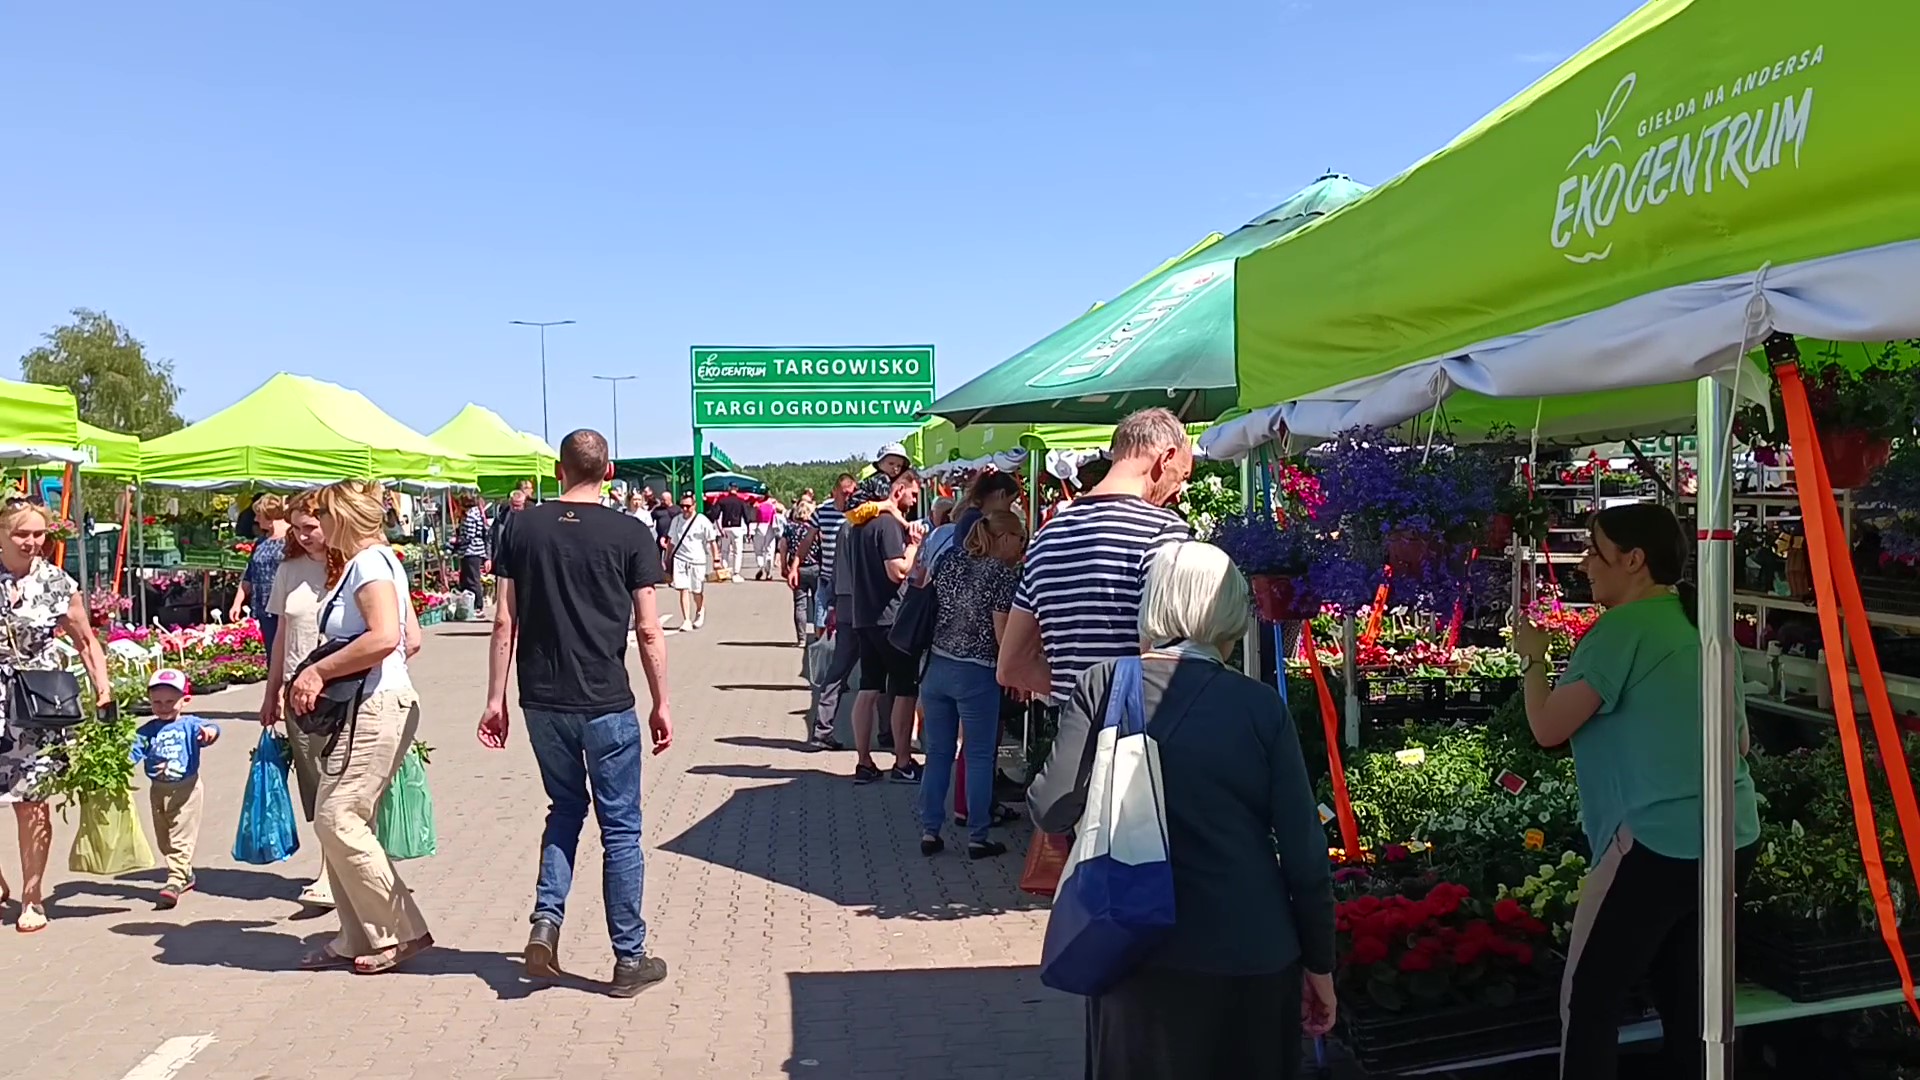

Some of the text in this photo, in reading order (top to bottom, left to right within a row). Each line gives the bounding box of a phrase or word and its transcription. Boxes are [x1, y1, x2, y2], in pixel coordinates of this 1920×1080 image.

[1637, 44, 1824, 137] GIEŁDA NA ANDERSA
[773, 358, 920, 375] TARGOWISKO
[704, 400, 924, 416] TARGI OGRODNICTWA
